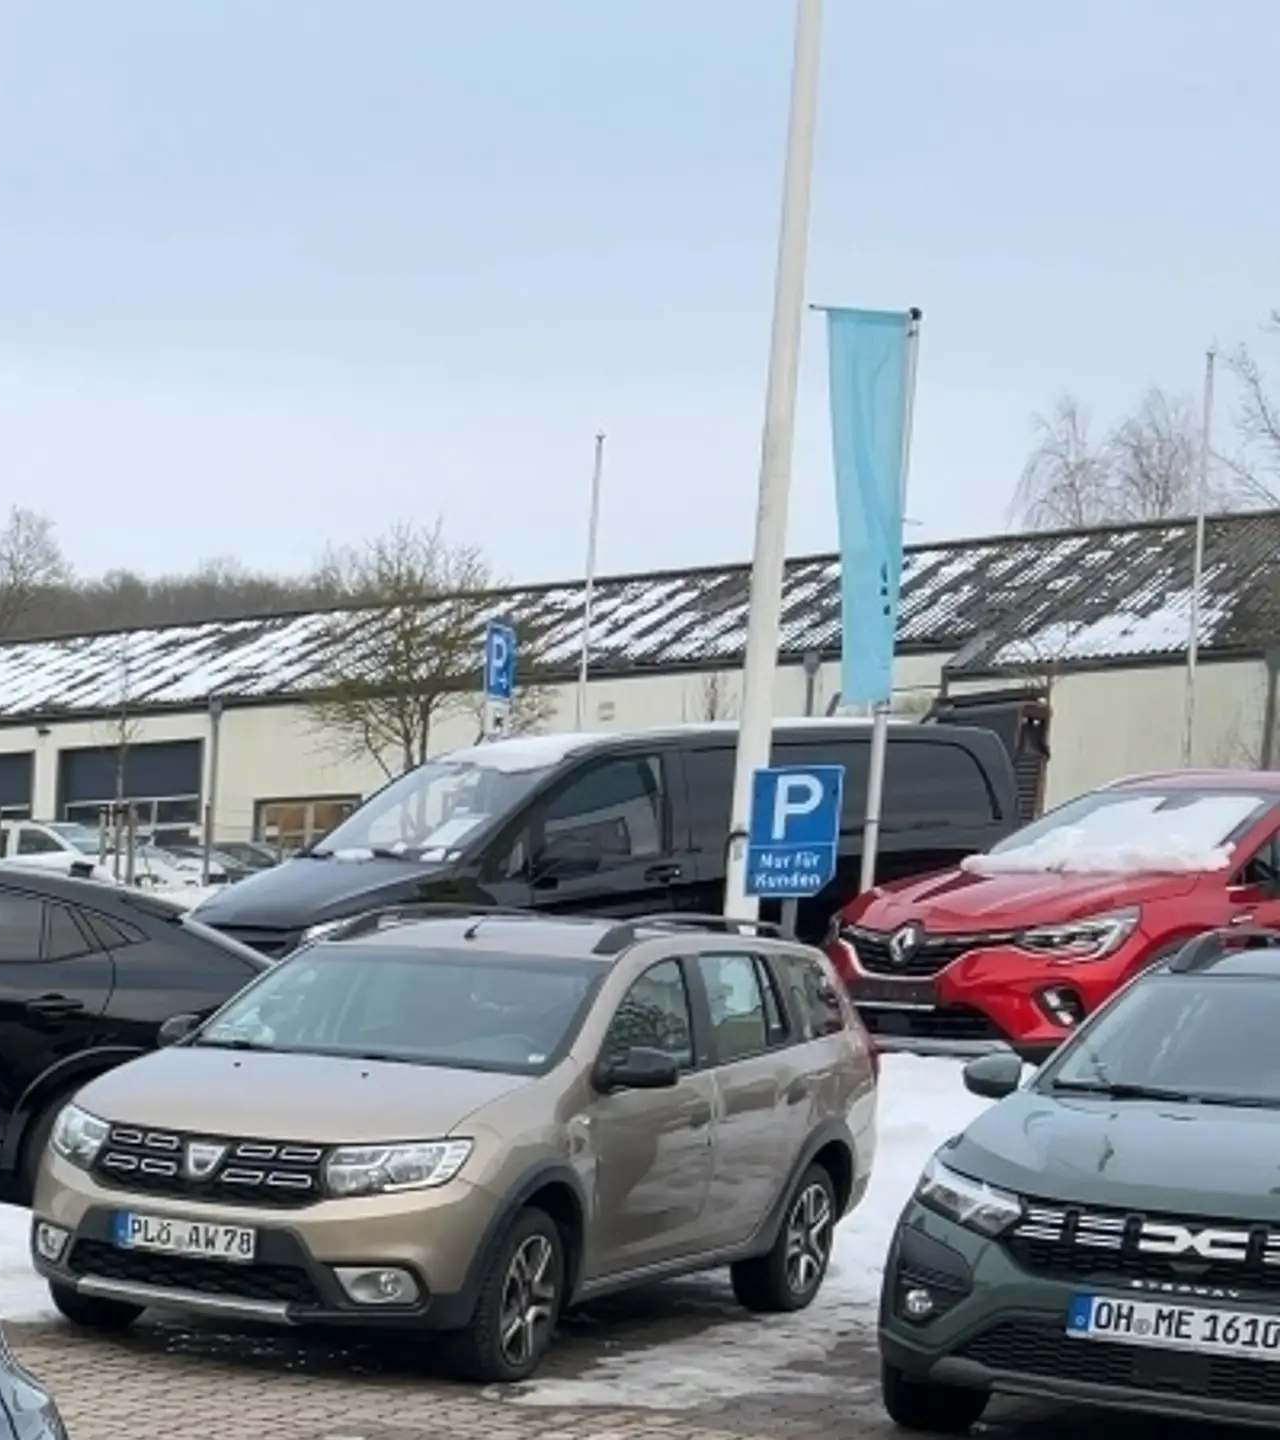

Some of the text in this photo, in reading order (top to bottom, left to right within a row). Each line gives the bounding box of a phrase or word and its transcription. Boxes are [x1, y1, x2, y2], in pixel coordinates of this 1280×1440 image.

[490, 634, 508, 687] P
[771, 774, 824, 840] P
[759, 851, 821, 869] Nur für
[755, 872, 821, 889] Kunden
[132, 1219, 171, 1245] PLÖ
[1094, 1302, 1134, 1332] OH
[1152, 1308, 1195, 1339] ME
